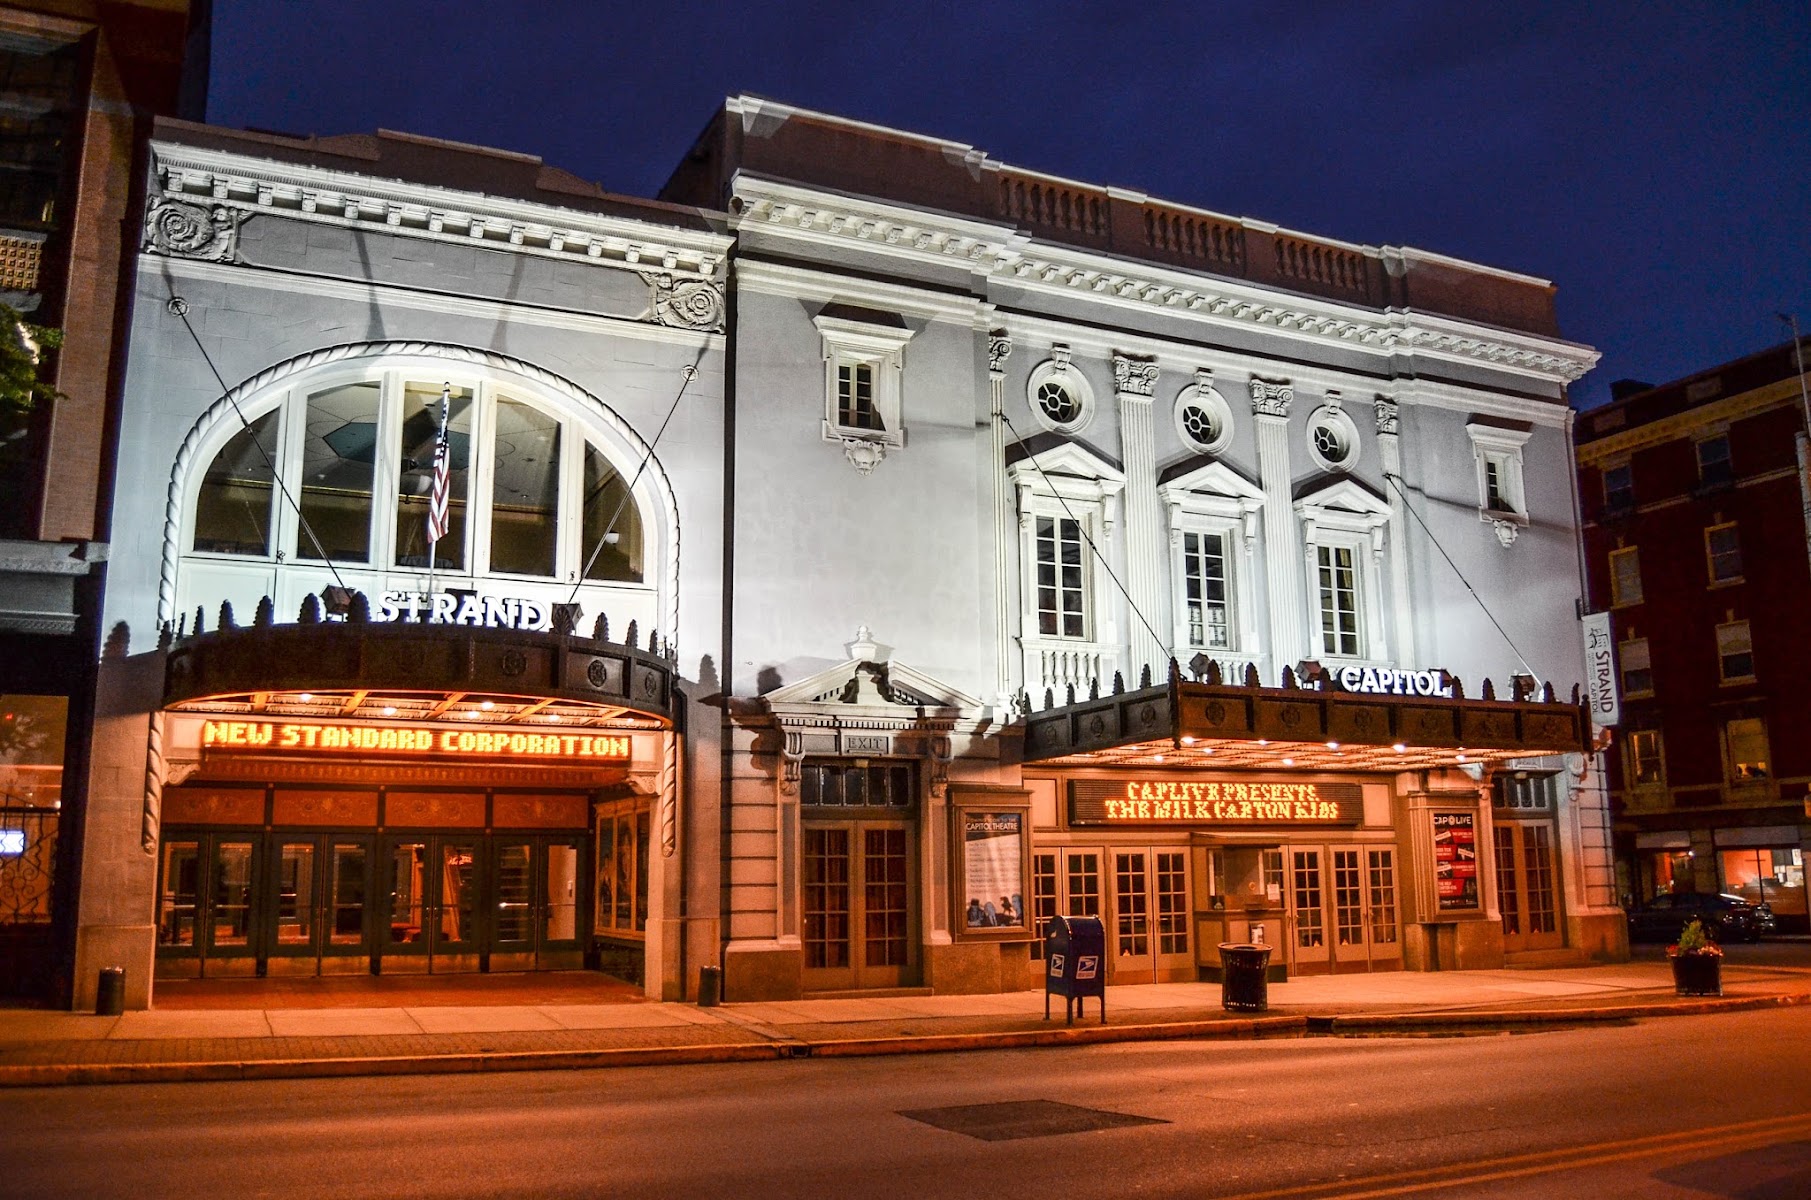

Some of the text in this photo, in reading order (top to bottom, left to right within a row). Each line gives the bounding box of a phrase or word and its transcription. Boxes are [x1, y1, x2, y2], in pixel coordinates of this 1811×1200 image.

[378, 590, 549, 631] STRAND
[1341, 666, 1452, 697] CAPITOL
[1595, 650, 1614, 713] STRAND
[1590, 682, 1599, 714] CAPITOL
[203, 721, 629, 757] NEW STANDARD CORPORATION
[848, 737, 882, 749] EXIT
[1104, 800, 1339, 819] THE MILK CARTON KIDS
[966, 822, 1018, 831] CAPITOL THEATRE
